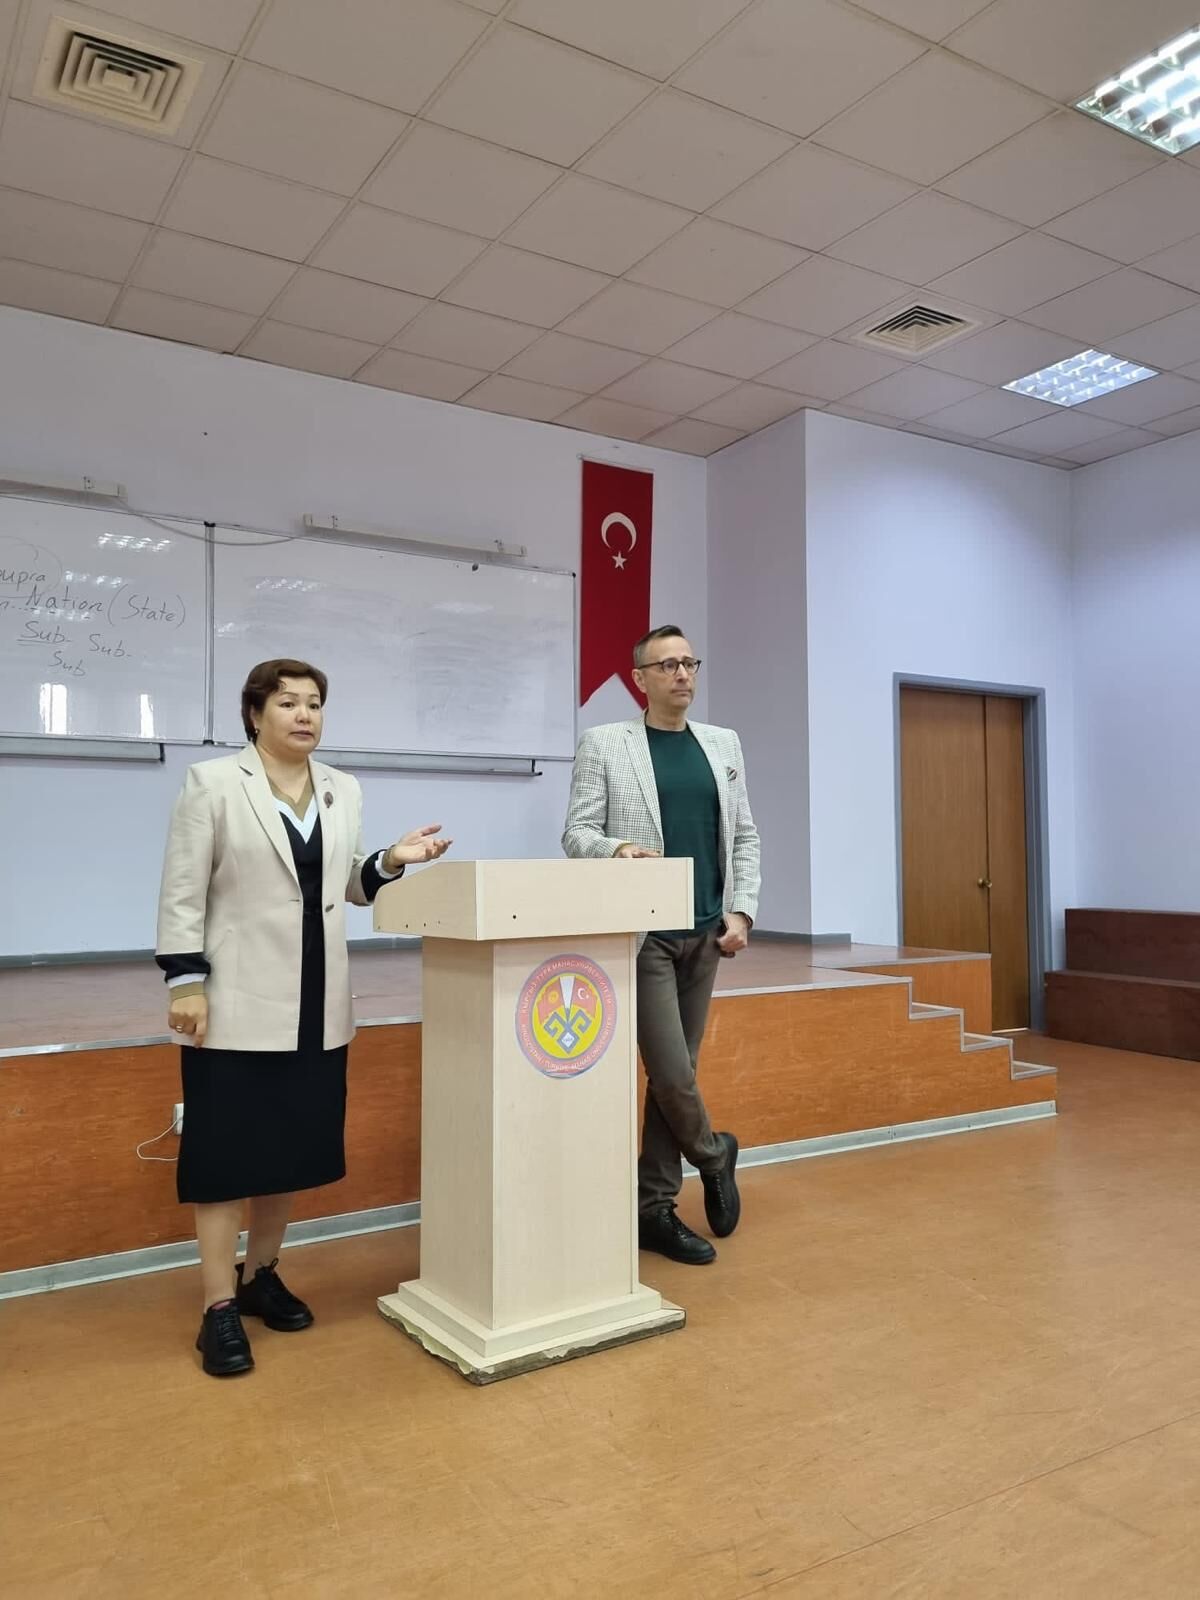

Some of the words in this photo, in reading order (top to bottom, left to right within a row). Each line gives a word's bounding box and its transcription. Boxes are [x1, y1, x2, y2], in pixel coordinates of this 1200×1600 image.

[0, 569, 46, 592] upra
[26, 584, 104, 612] Nation
[49, 650, 86, 677] Sub
